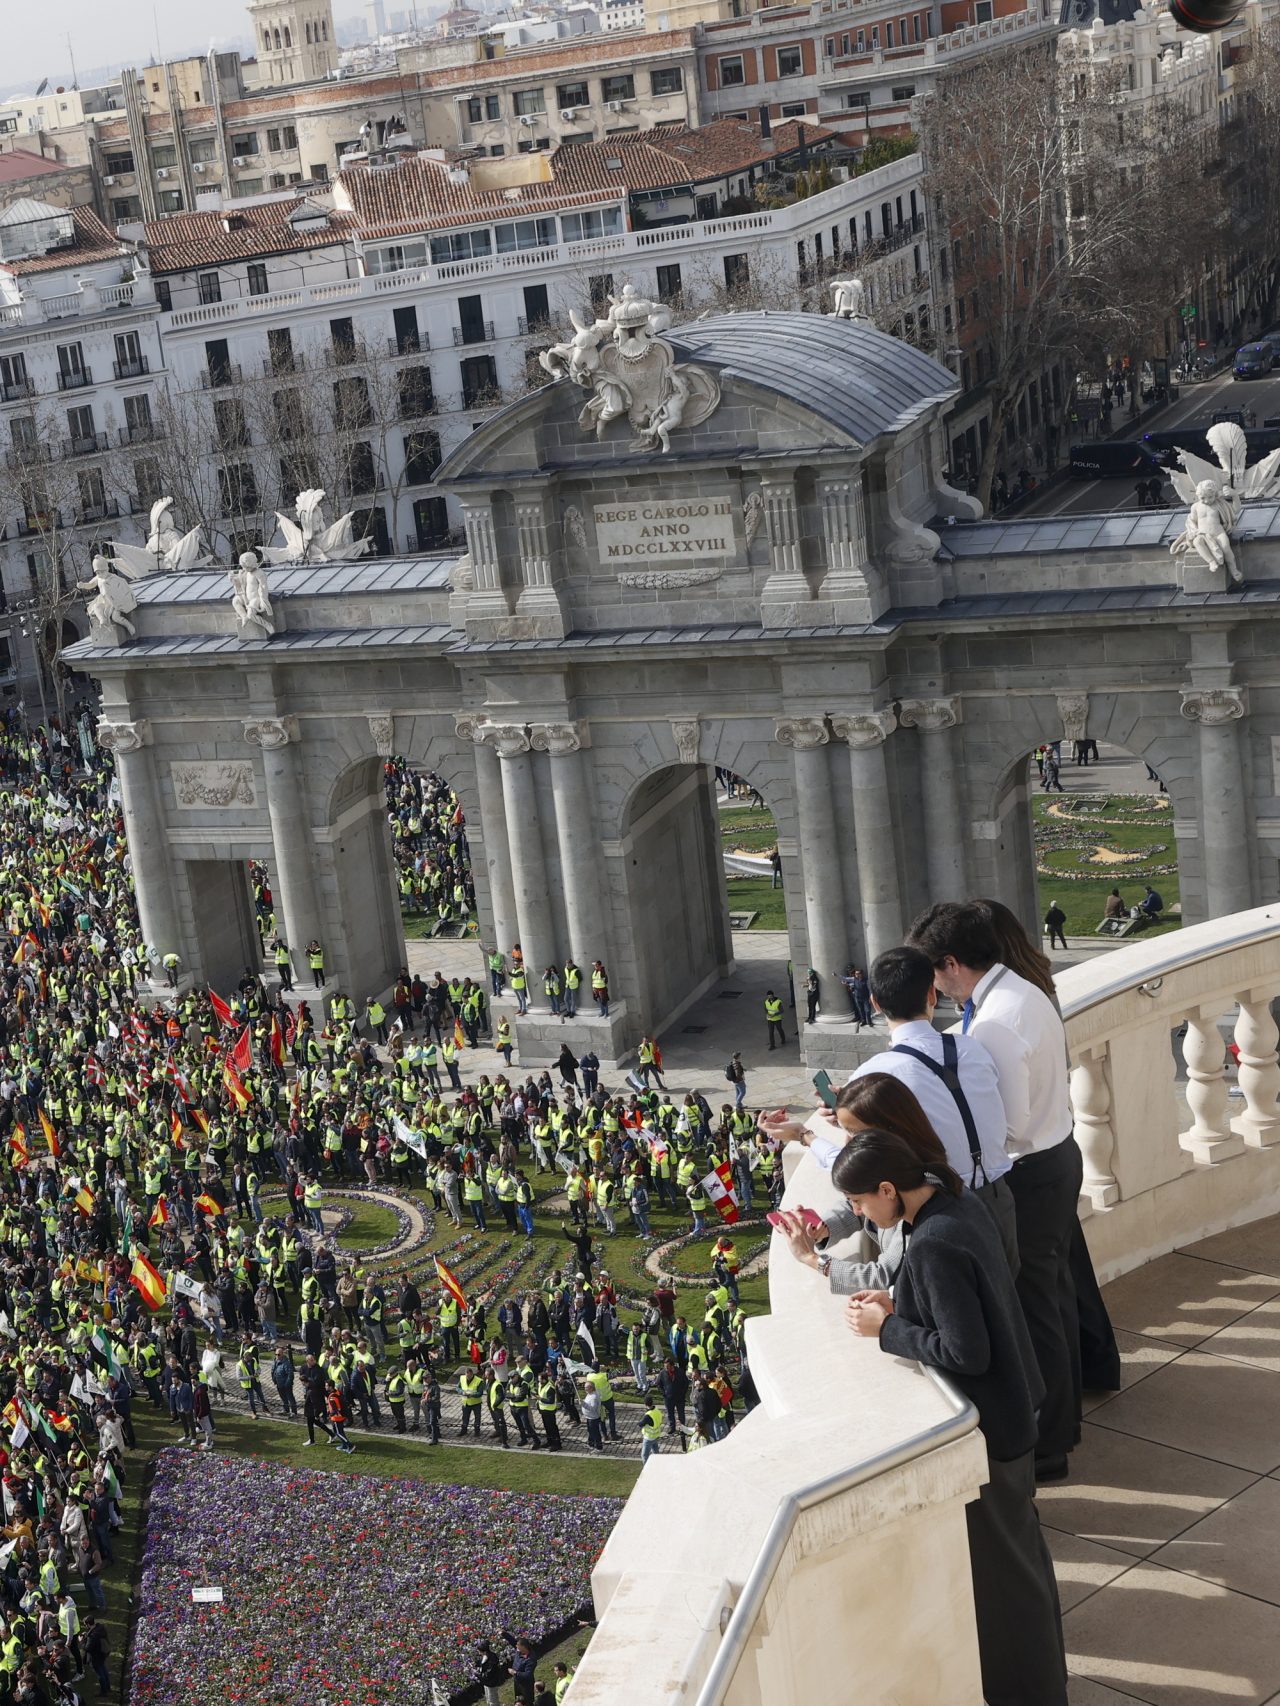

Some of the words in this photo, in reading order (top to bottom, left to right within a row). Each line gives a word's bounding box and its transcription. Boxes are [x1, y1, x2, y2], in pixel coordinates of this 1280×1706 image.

[595, 510, 637, 523] REGE
[642, 505, 709, 519] CAROLO
[714, 504, 732, 515] III
[640, 524, 690, 537] ANNO
[607, 538, 726, 556] MDCCLXXVIII
